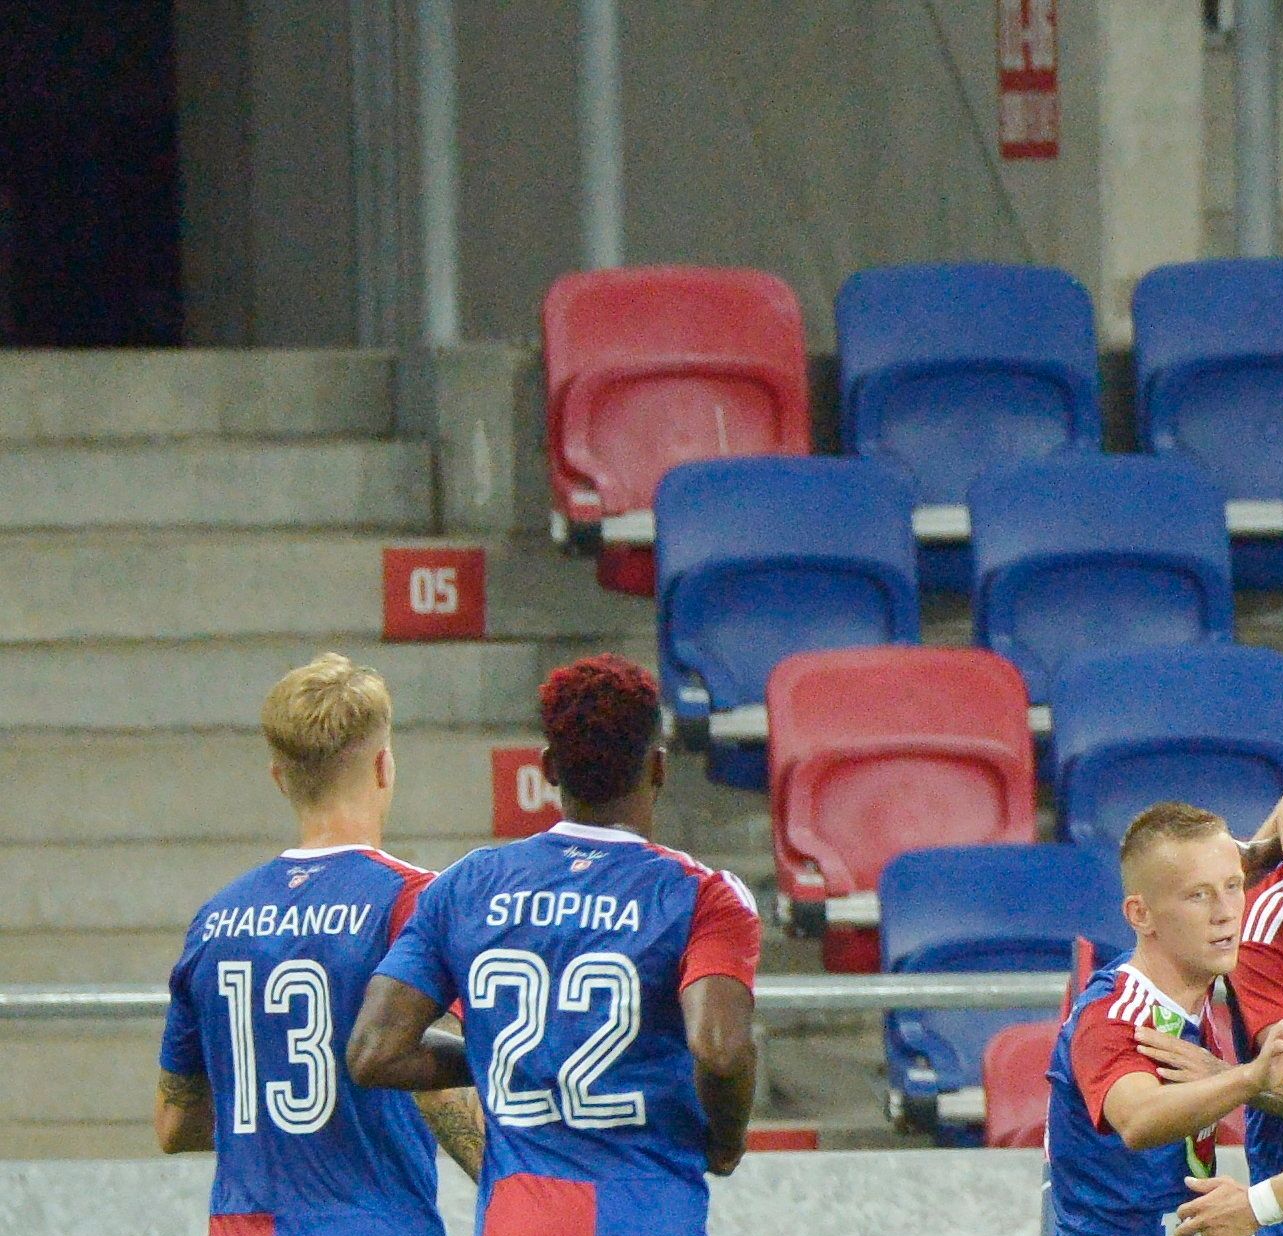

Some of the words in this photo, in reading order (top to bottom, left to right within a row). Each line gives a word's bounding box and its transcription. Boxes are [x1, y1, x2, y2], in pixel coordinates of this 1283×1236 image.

[410, 567, 457, 614] 05
[202, 903, 370, 942] SHABANOV
[486, 890, 641, 932] STOPIRA
[218, 959, 336, 1134] 13
[468, 948, 646, 1129] 22
